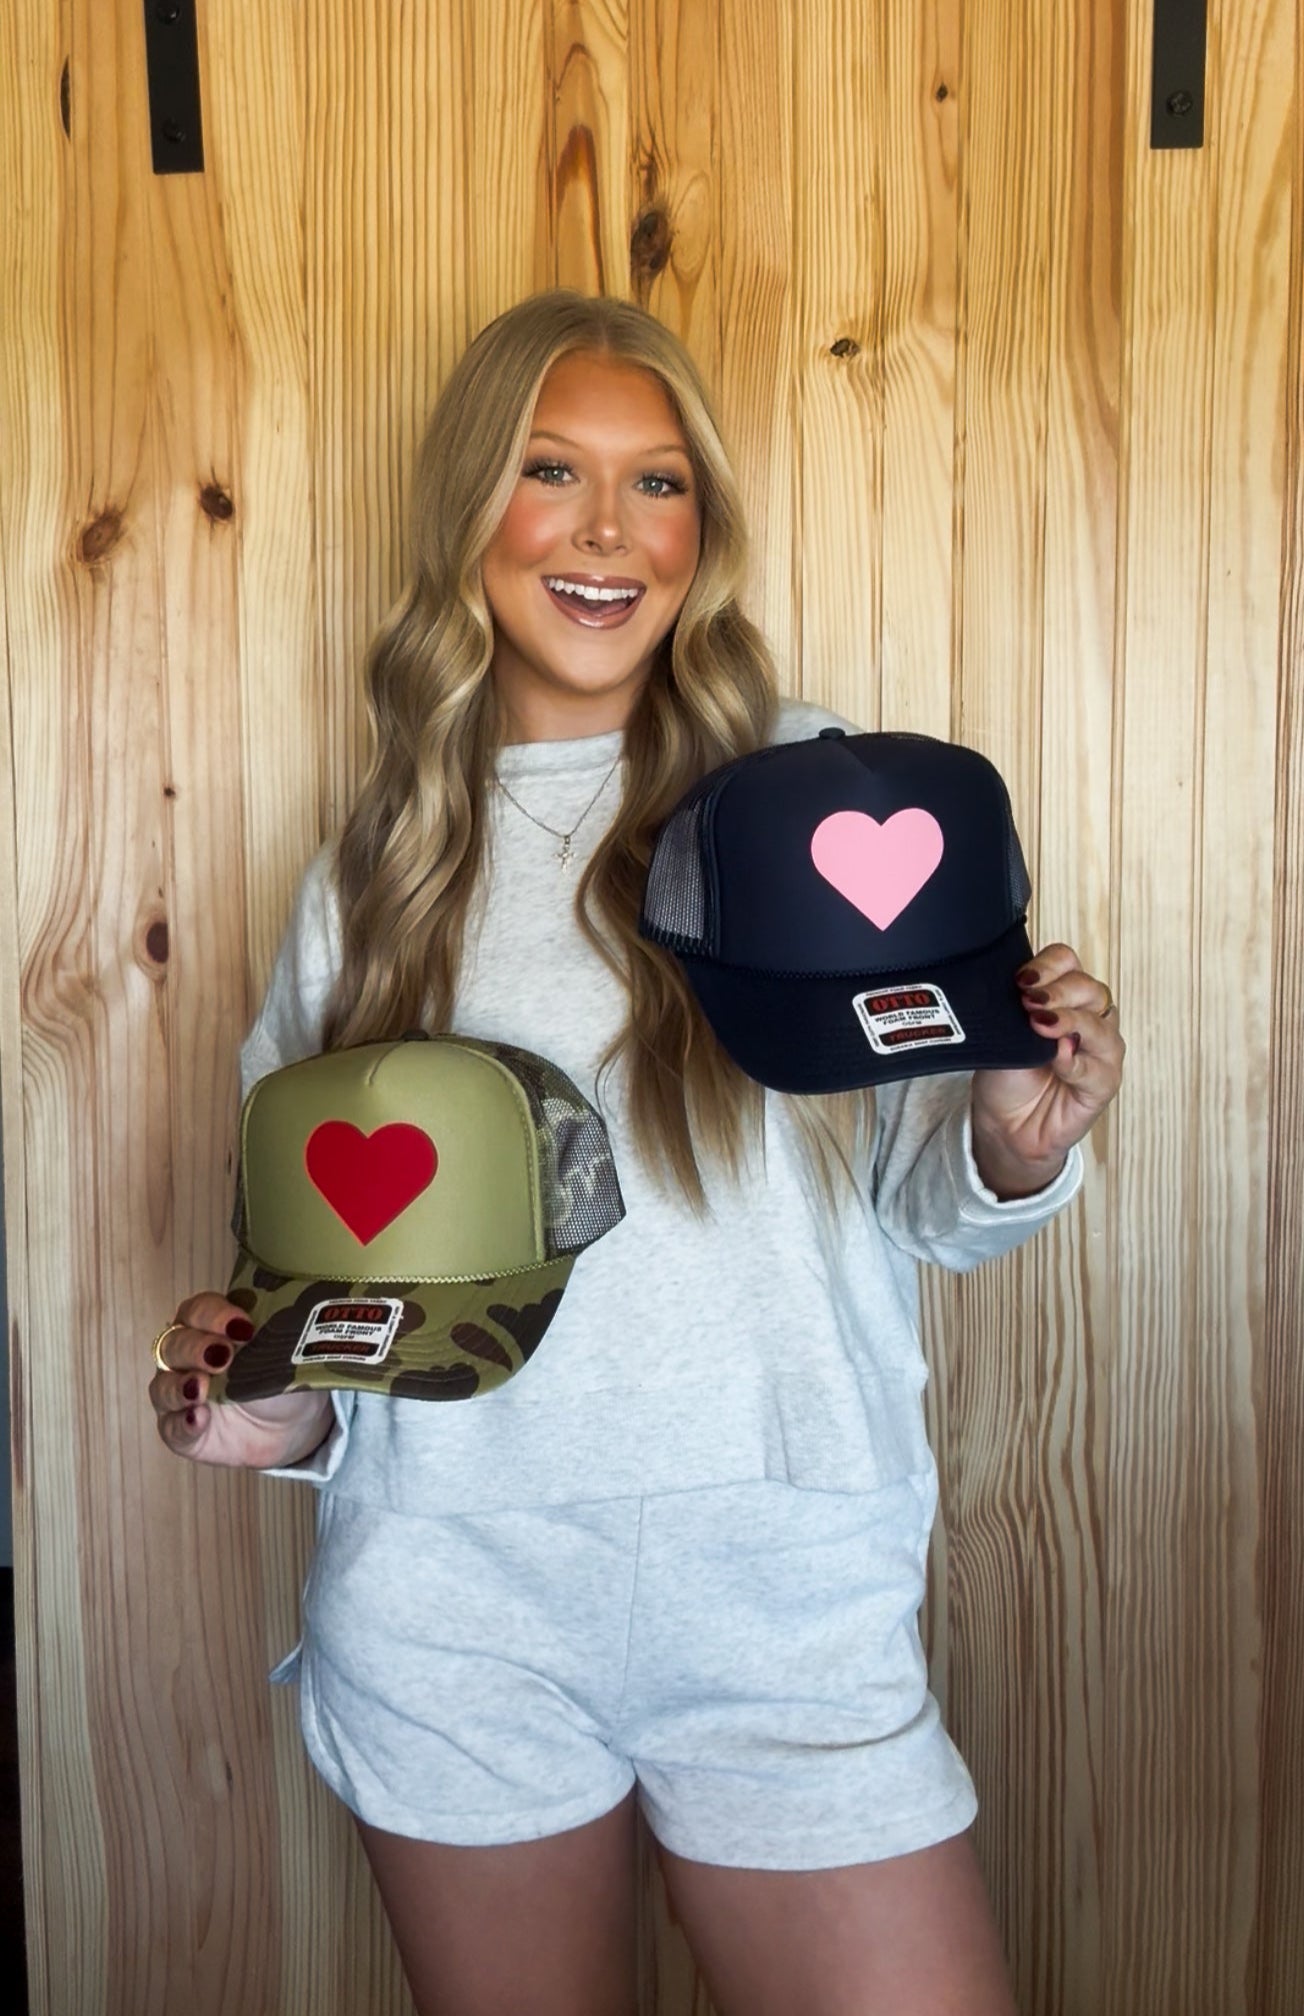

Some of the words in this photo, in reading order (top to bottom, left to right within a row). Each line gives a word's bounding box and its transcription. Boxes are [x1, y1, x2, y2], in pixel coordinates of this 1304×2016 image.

[872, 992, 931, 1012] OTTO
[875, 1012, 904, 1022] WORLD
[883, 1017, 906, 1025] FOAM
[889, 1027, 946, 1042] TRUCKER
[324, 1307, 383, 1321] OTTO
[347, 1324, 382, 1332] FAMOUS
[311, 1342, 369, 1352] TRUCKER
